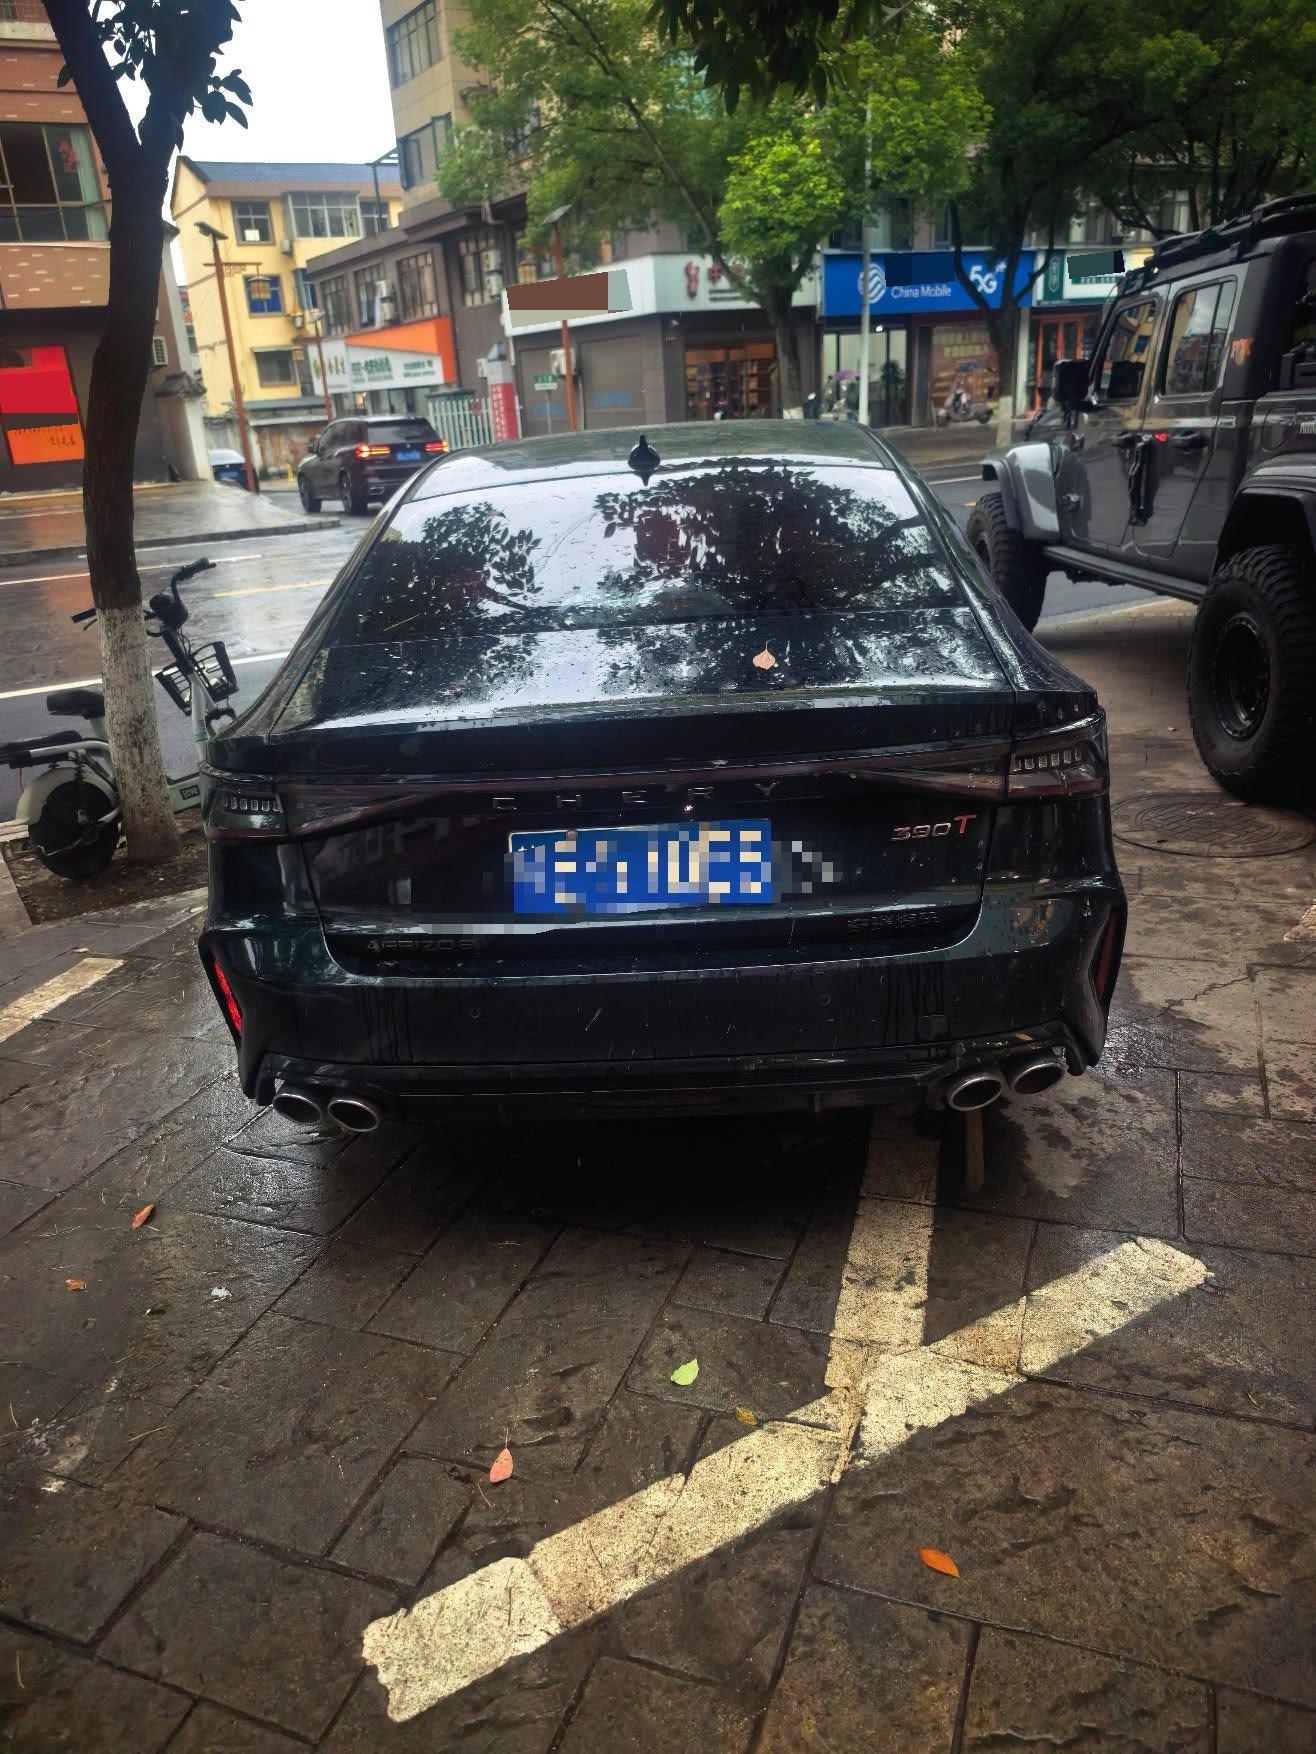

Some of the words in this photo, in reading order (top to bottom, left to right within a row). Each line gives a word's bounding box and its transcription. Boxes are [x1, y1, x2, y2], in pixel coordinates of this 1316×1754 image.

[890, 285, 920, 299] China
[920, 284, 952, 298] Mobile
[890, 814, 978, 841] 390T
